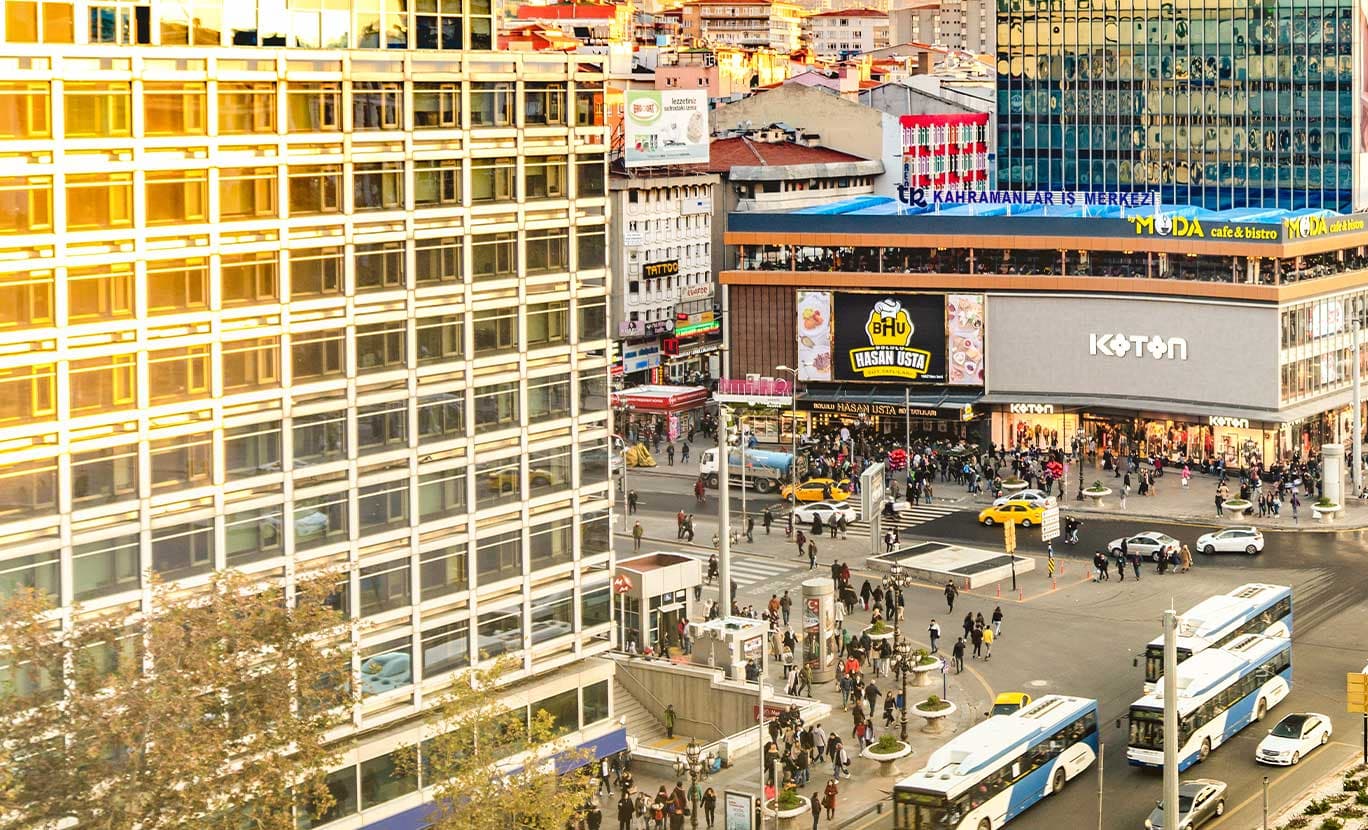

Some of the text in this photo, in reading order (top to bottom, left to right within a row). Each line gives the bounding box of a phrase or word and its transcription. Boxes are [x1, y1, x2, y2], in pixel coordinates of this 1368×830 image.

[933, 190, 1055, 205] KAHRAMANLAR
[1061, 188, 1076, 208] İŞ
[1084, 189, 1155, 207] MERKEZİ
[1135, 214, 1205, 238] MODA
[1211, 225, 1234, 238] cafe
[1245, 225, 1278, 240] bistro
[1288, 215, 1327, 240] MODA
[645, 262, 678, 276] TATTOO
[1089, 332, 1188, 361] KOTON
[855, 350, 925, 370] HASAN USTA
[837, 402, 869, 415] HASAN
[872, 404, 897, 416] USTA
[1010, 403, 1054, 414] KOTON
[1209, 415, 1249, 429] KOTON
